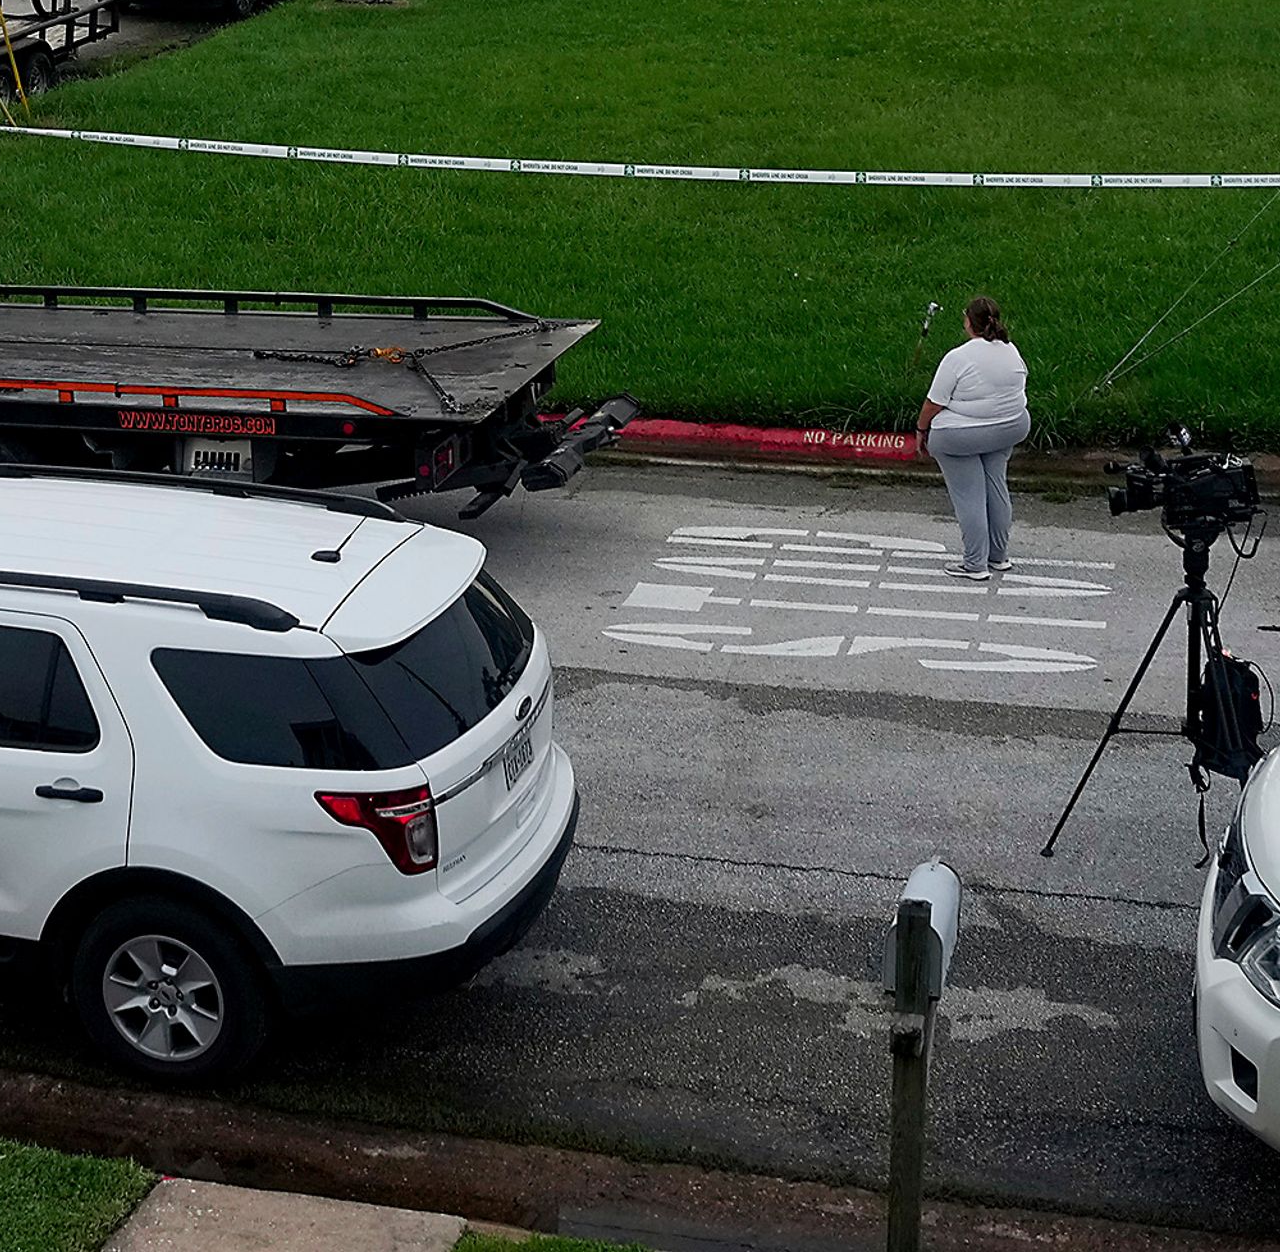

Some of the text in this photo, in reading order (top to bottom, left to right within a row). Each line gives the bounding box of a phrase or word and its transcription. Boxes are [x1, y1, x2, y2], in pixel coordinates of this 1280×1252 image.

[118, 411, 276, 436] WWW.TONYBROS.COM
[803, 431, 905, 448] NO PARKING
